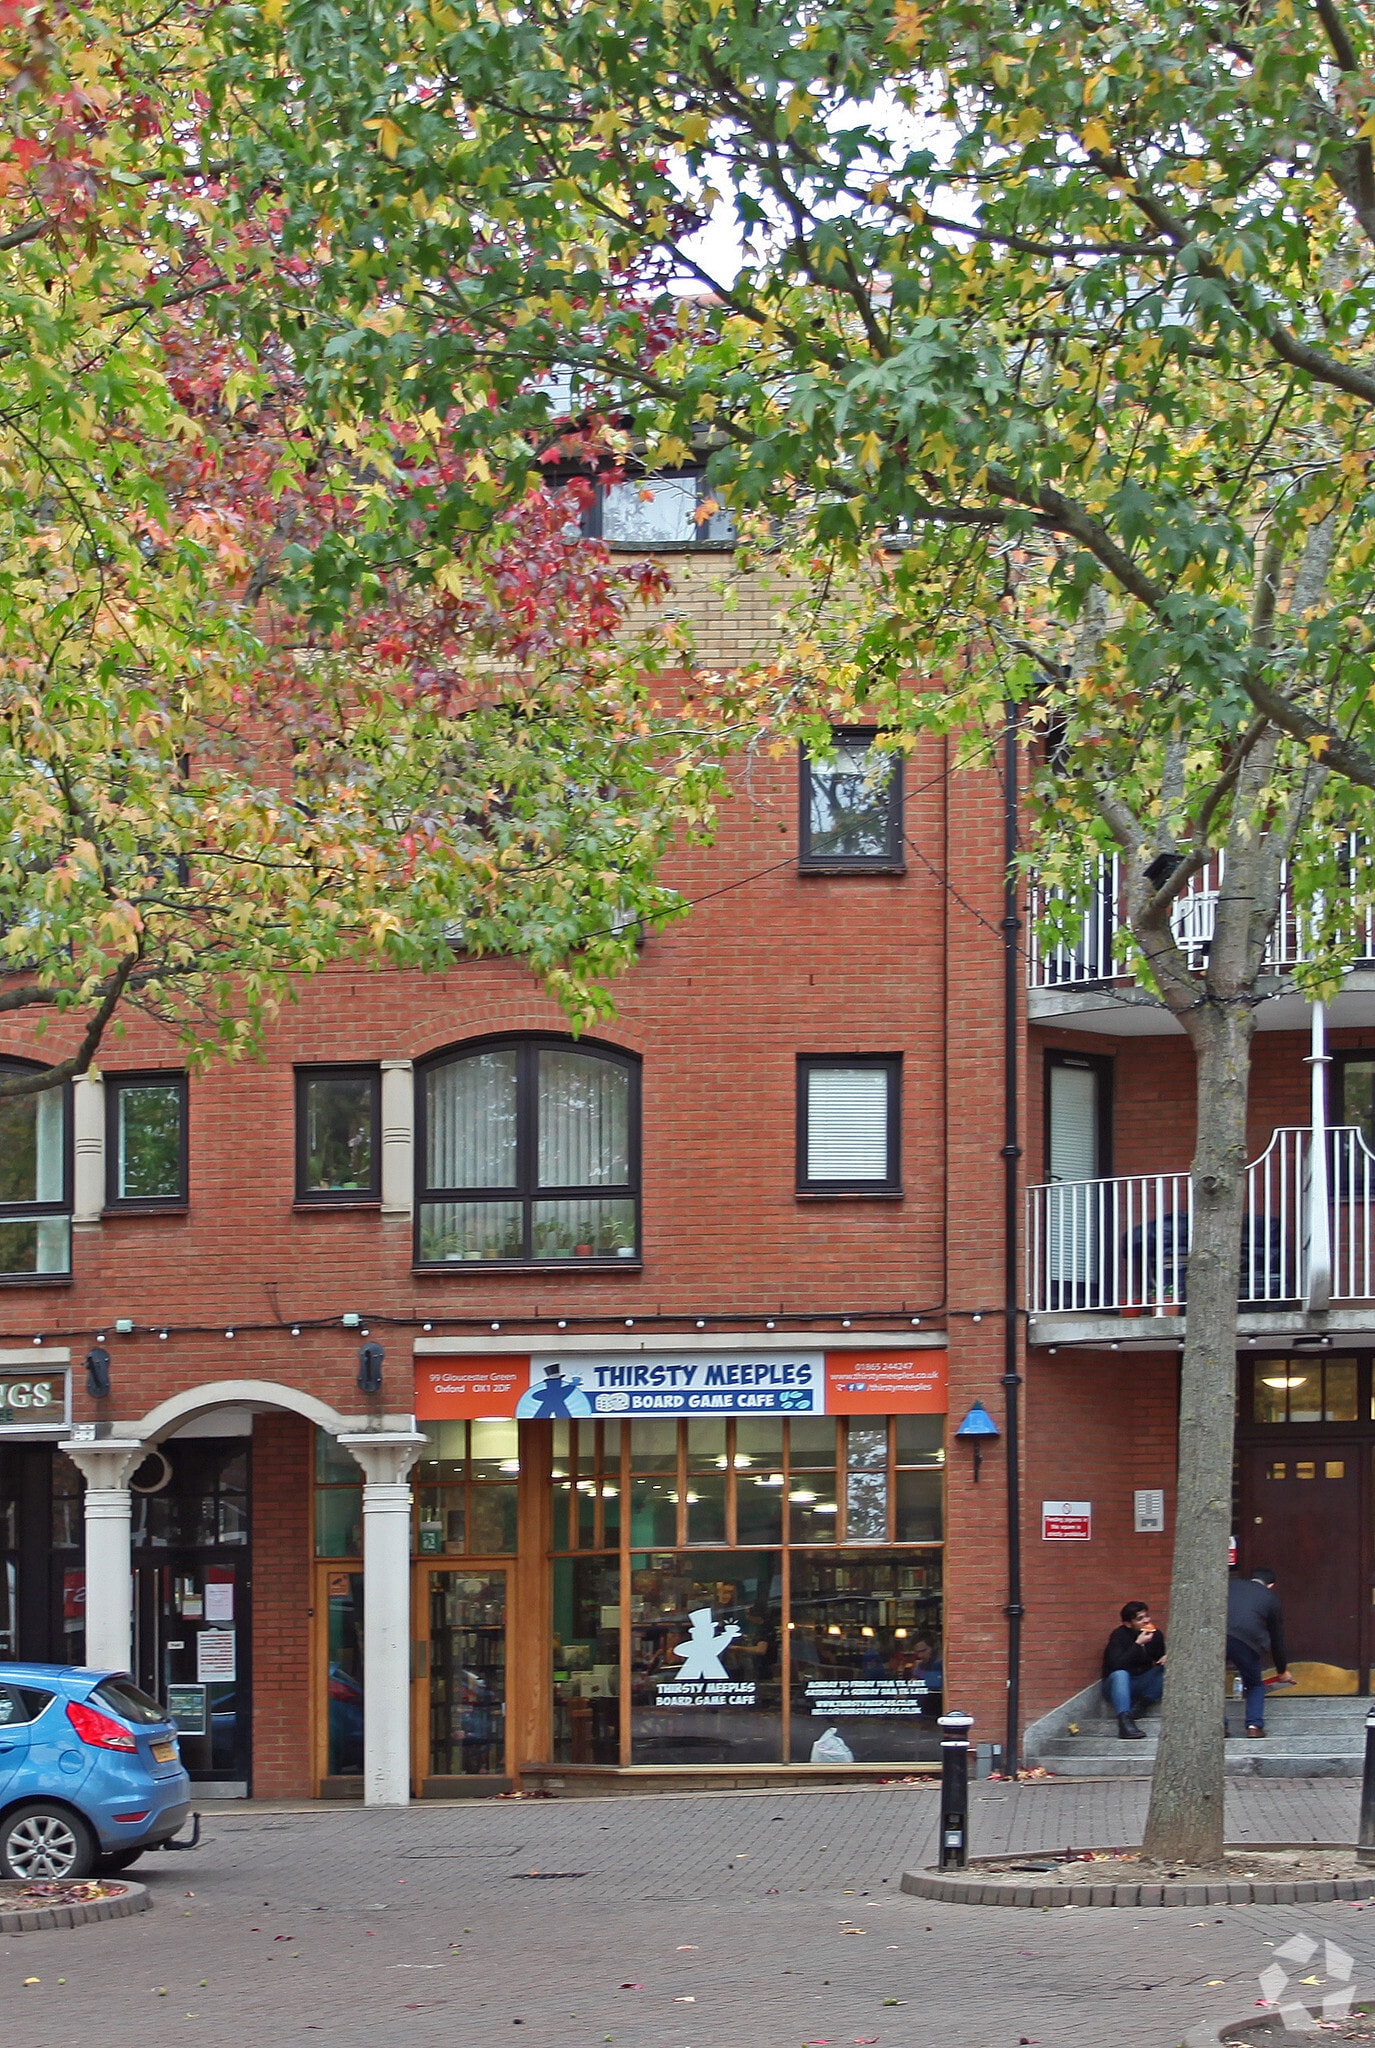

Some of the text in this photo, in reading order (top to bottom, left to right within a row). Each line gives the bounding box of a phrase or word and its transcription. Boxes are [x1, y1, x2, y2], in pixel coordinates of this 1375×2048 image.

[430, 1373, 517, 1382] 99 Gloucester Green
[594, 1363, 813, 1387] THIRSTY MEEPLES
[830, 1371, 939, 1381] www.thirstymeeples.co.uk
[435, 1384, 512, 1393] Oxford OX1 2DF
[867, 1383, 932, 1392] /thirstymeeples
[632, 1393, 775, 1409] BOARD GAME CAFE
[656, 1682, 756, 1694] THIRSTY MEEPLES
[656, 1696, 755, 1706] BOARD GAME CAFE
